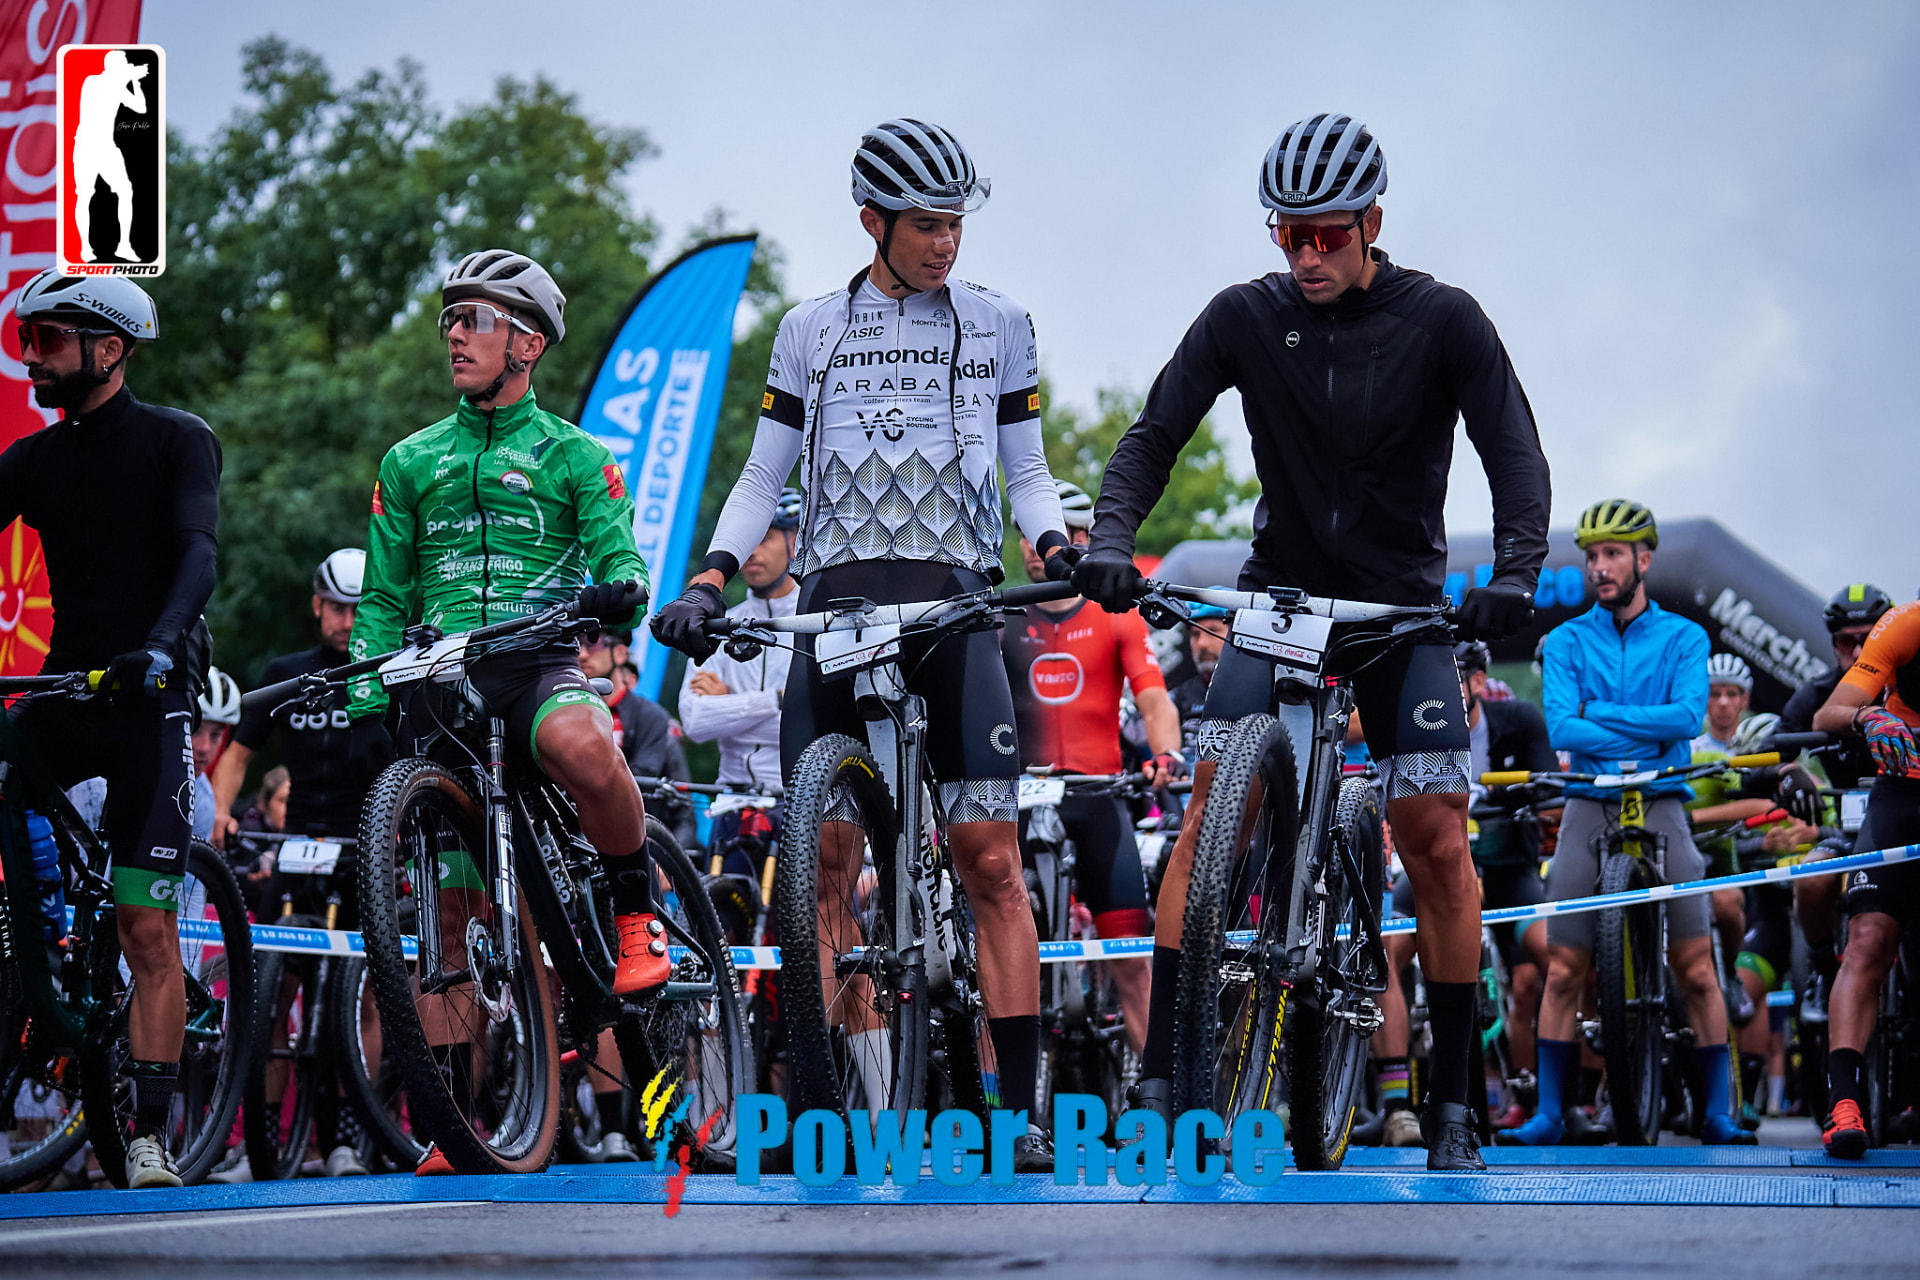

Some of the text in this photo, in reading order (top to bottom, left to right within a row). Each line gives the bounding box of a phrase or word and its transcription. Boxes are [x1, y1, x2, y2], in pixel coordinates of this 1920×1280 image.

[1284, 192, 1303, 200] CRUZ
[73, 292, 143, 333] S-WORKS
[911, 319, 938, 328] MONTE
[906, 422, 938, 430] BOUTIQUE
[643, 372, 692, 524] DEPORTE
[414, 644, 435, 661] 2
[1021, 780, 1046, 797] 22
[302, 845, 319, 859] 11
[718, 937, 742, 999] RENEGADE
